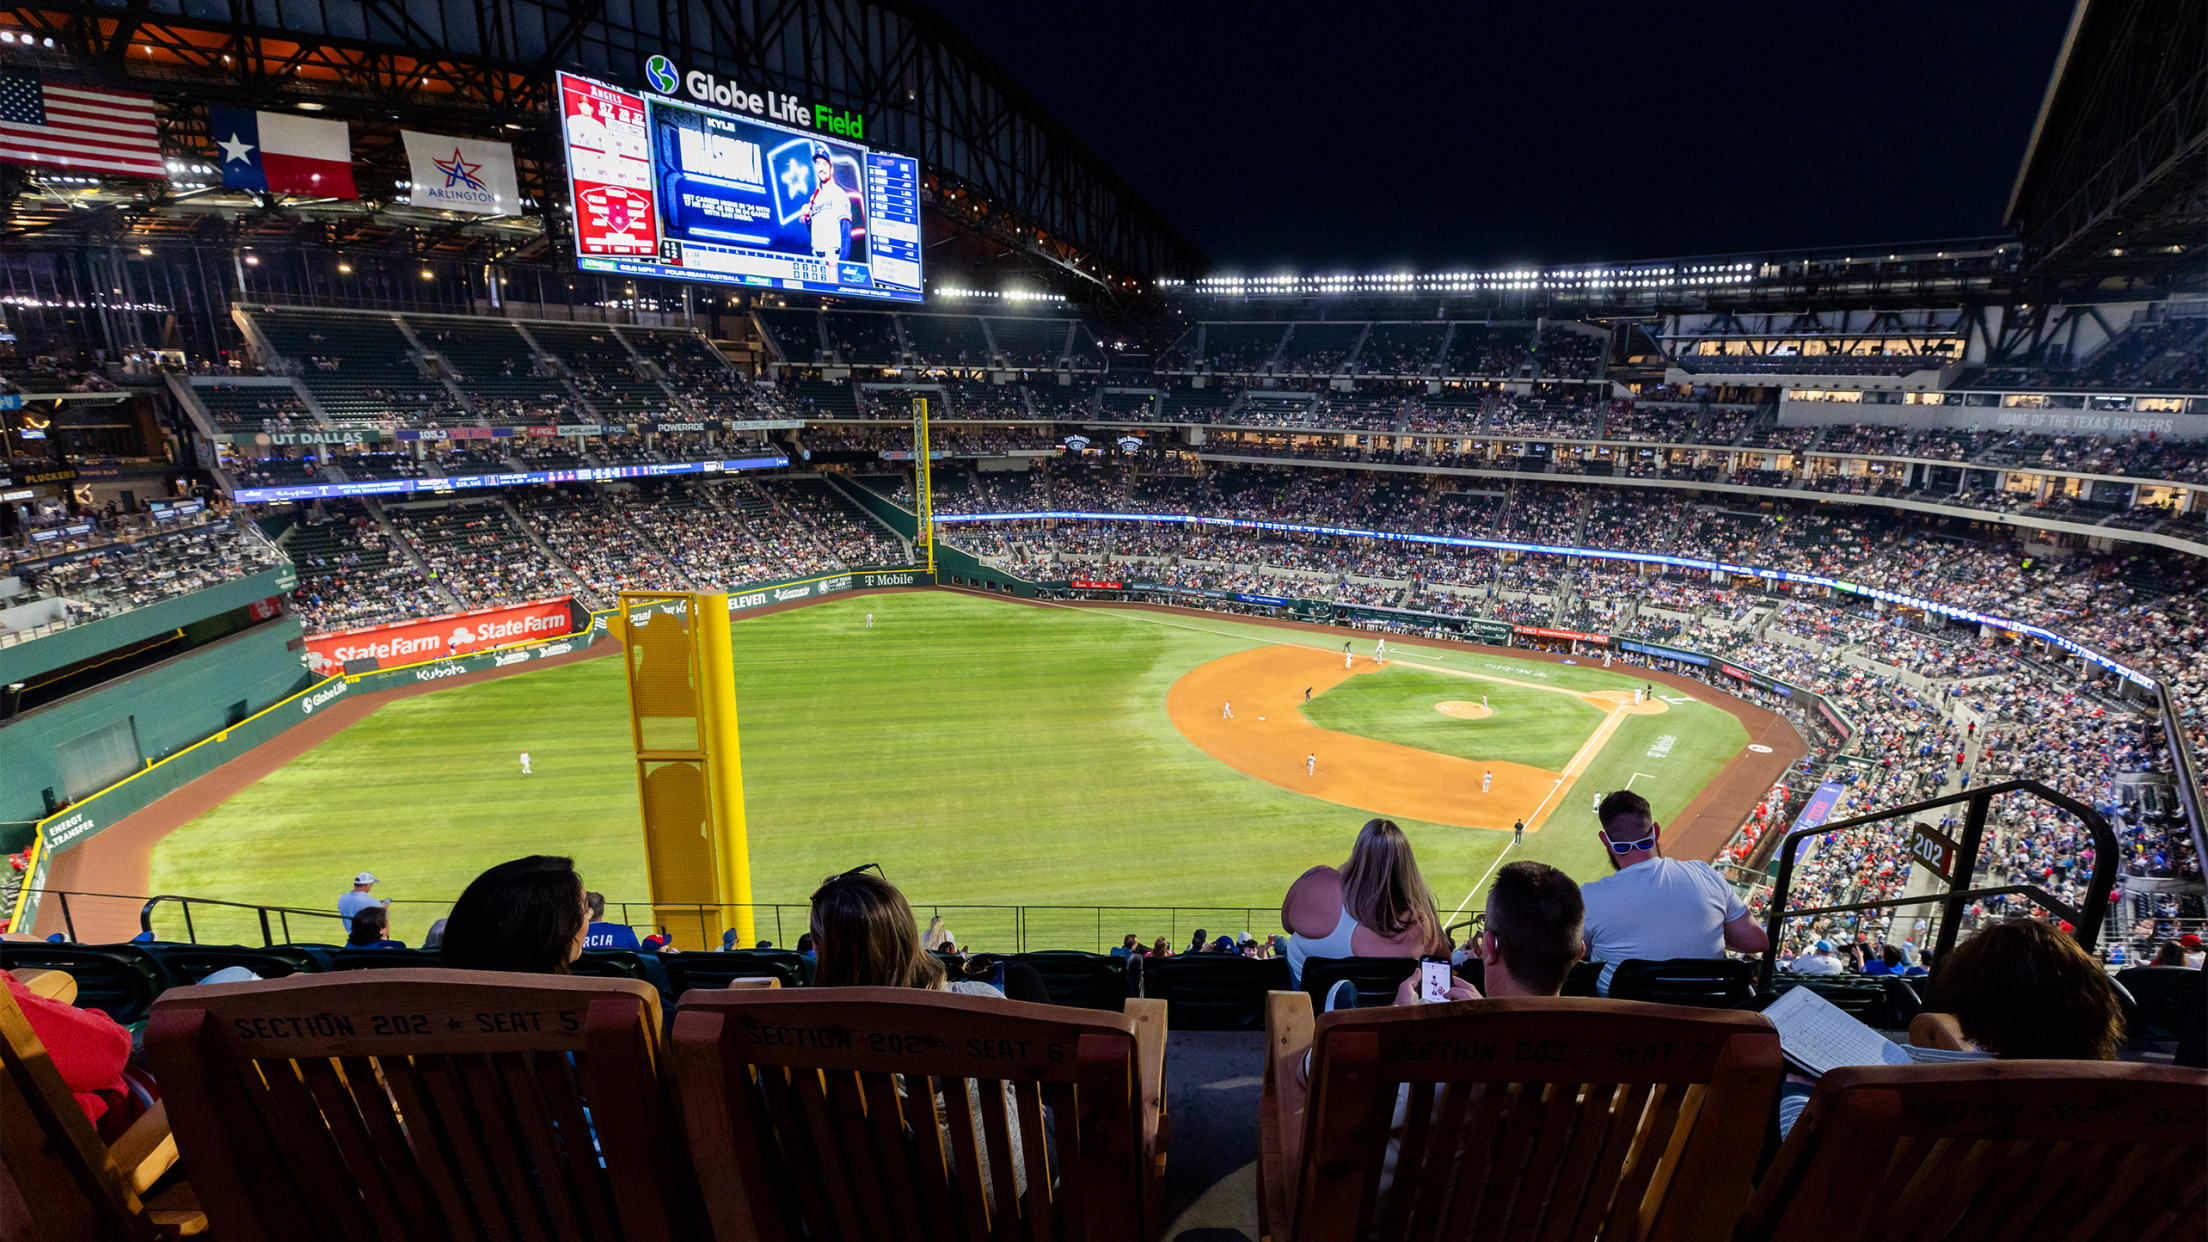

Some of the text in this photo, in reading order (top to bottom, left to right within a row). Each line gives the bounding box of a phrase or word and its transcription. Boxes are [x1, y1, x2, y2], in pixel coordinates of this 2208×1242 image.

[686, 70, 863, 139] Globe Life Field
[707, 118, 736, 132] KYLE
[428, 187, 495, 202] ARLINGTON
[560, 425, 600, 434] GoPGL.com
[657, 422, 705, 432] POWERADE
[1998, 413, 2173, 433] HOME OF THE TEXAS RANGERS
[271, 431, 363, 445] UT DALLAS
[418, 429, 447, 439] 105.3
[447, 428, 469, 439] THE
[25, 469, 76, 484] PLUCKERS
[877, 573, 914, 585] Mobile
[728, 593, 767, 609] ELEVEN
[416, 664, 467, 681] Kubota
[48, 812, 83, 837] ENERGY
[52, 819, 95, 848] TRANSFER
[1913, 832, 1943, 869] 202
[582, 934, 613, 948] RCIA
[234, 1010, 580, 1039] SECTION 202 SEAT 5
[749, 1023, 1065, 1062] SECTION 202 SEAT 6
[1388, 1040, 1497, 1062] SECTION
[1513, 1041, 1569, 1062] 202
[1613, 1041, 1680, 1062] SEAT
